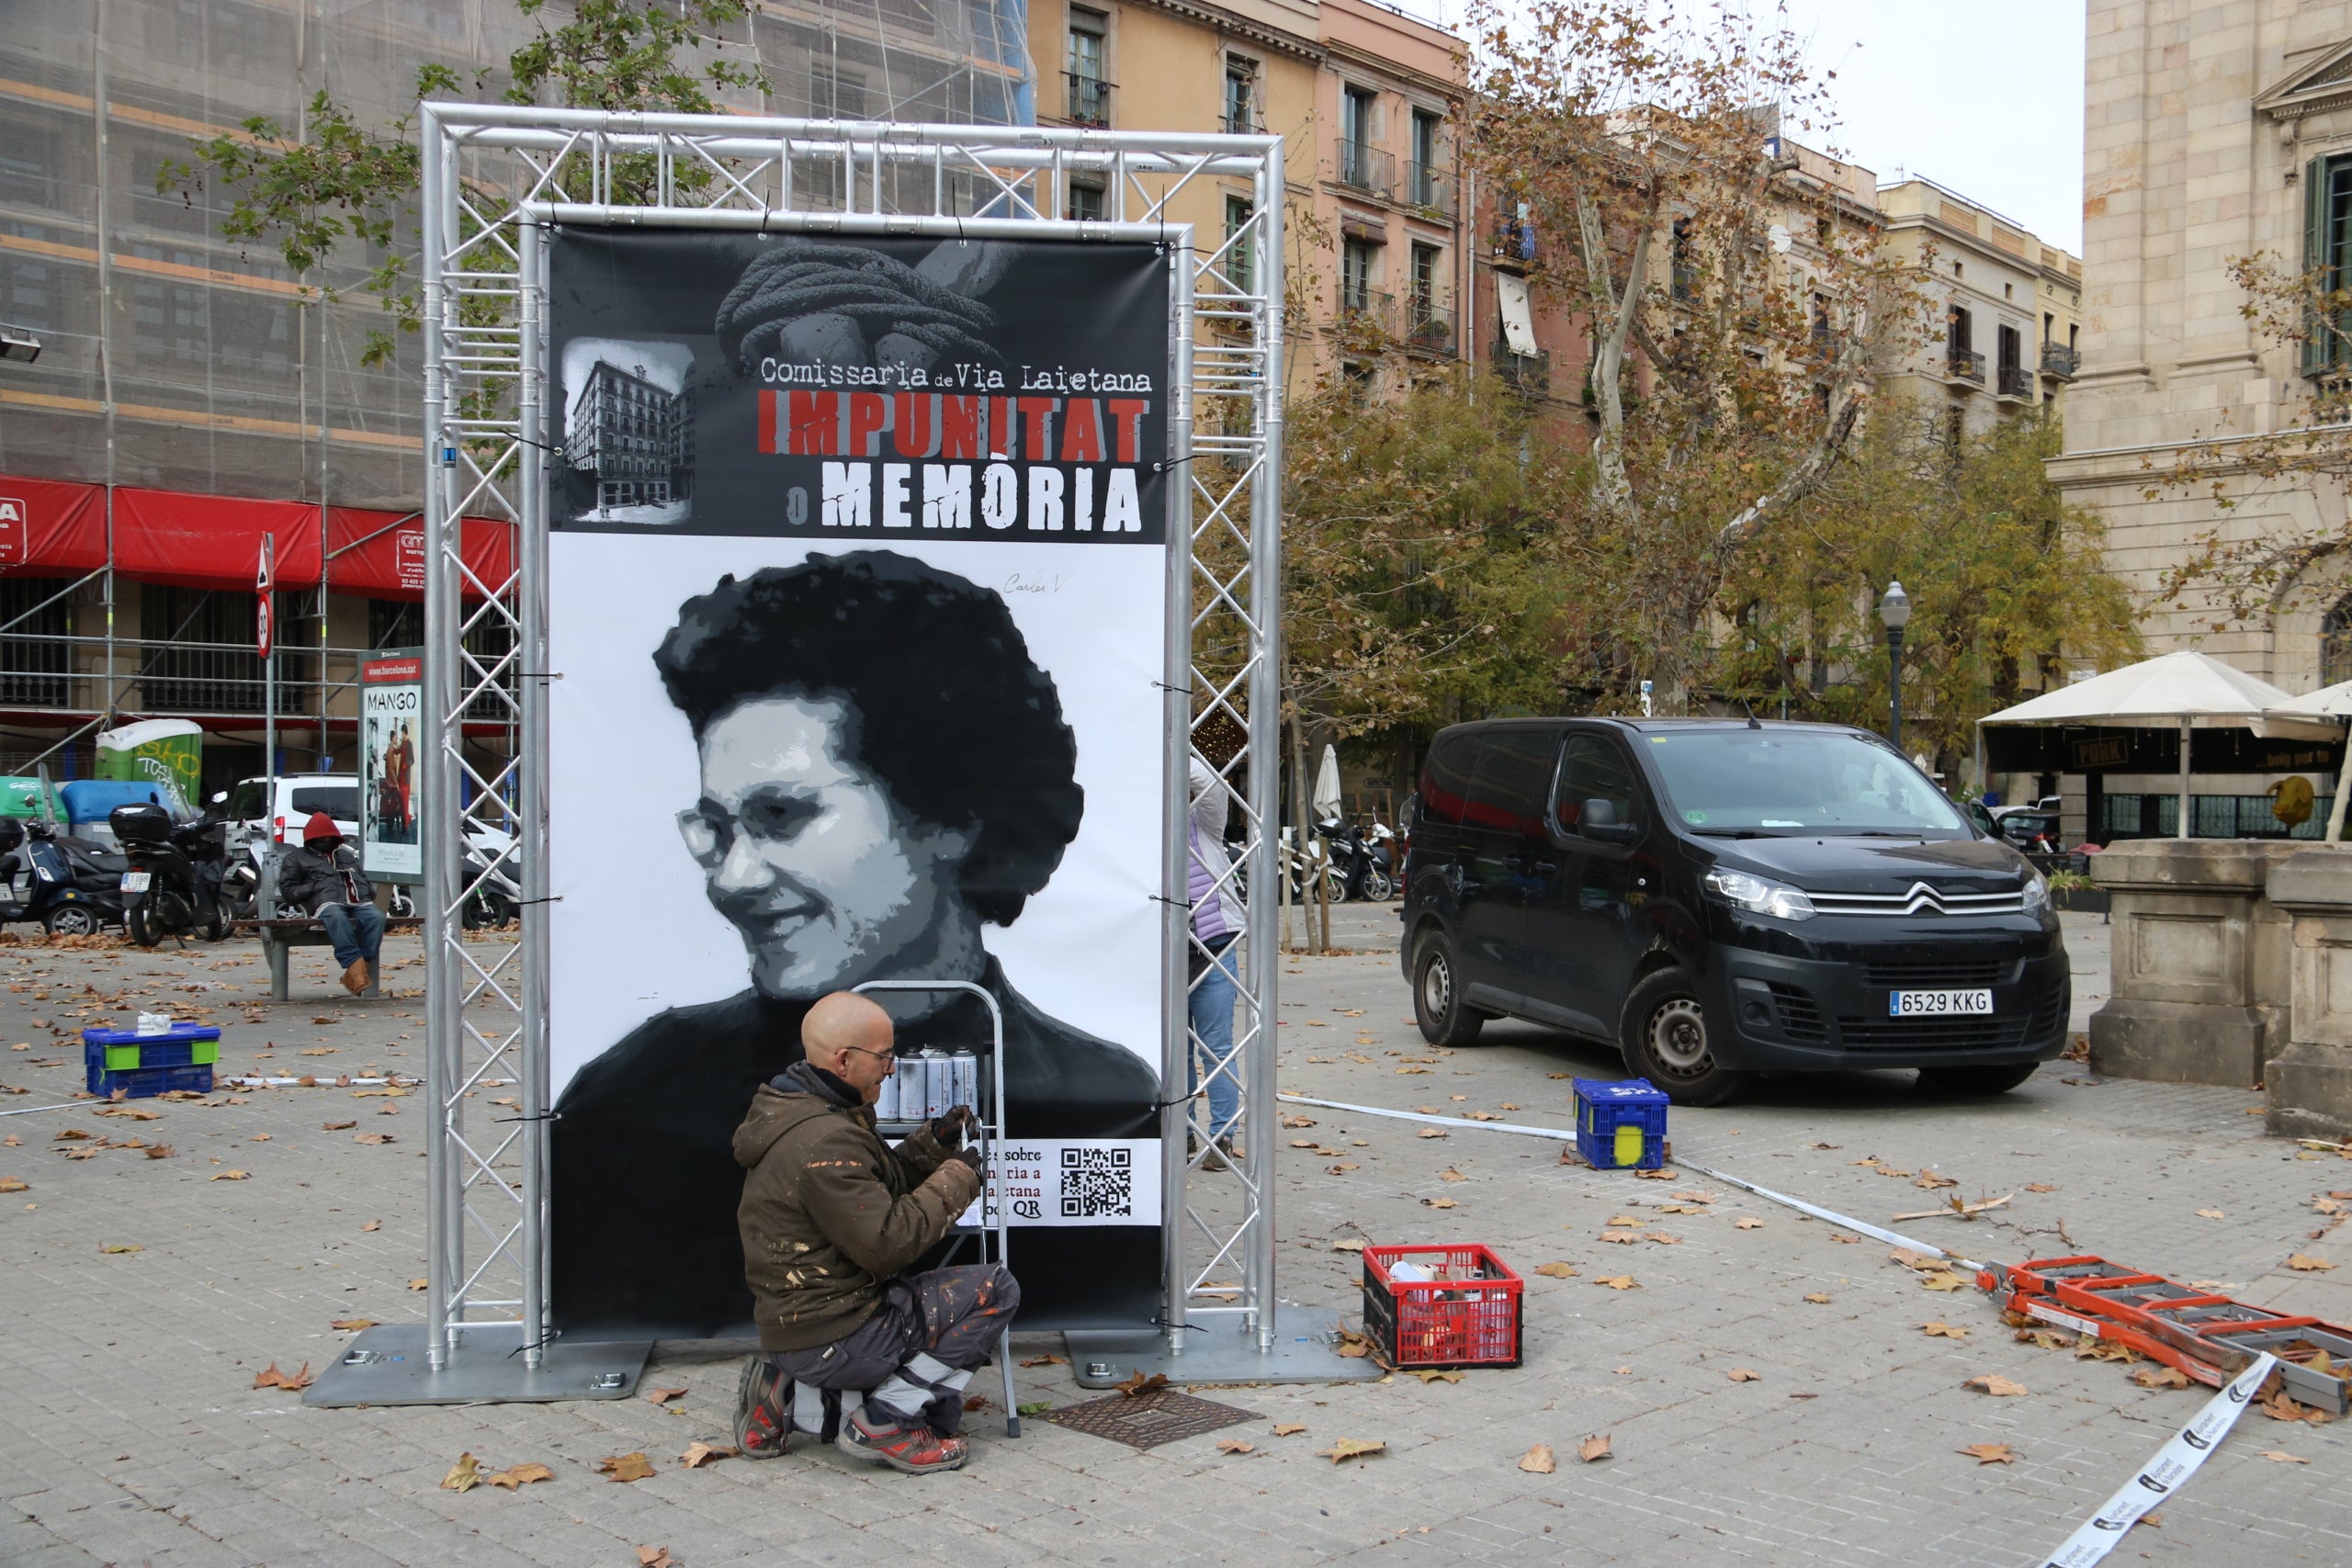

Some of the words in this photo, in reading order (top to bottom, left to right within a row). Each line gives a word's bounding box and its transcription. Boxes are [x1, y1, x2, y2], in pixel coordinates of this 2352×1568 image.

[762, 357, 928, 389] Comissaria
[934, 374, 953, 389] de
[955, 363, 1004, 391] Via
[1021, 366, 1153, 394] Laietana
[758, 389, 1149, 462] IMPUNITAT
[821, 453, 1142, 532] MEMÒRIA
[260, 614, 266, 636] 30
[368, 665, 416, 676] www.barcelona.cat
[368, 692, 416, 711] MANGO
[2078, 739, 2122, 764] PORK
[1902, 994, 1947, 1012] 6529
[1953, 992, 1986, 1011] KKG
[1005, 1146, 1044, 1161] sobre
[1033, 1169, 1041, 1179] a
[1013, 1200, 1042, 1219] QR
